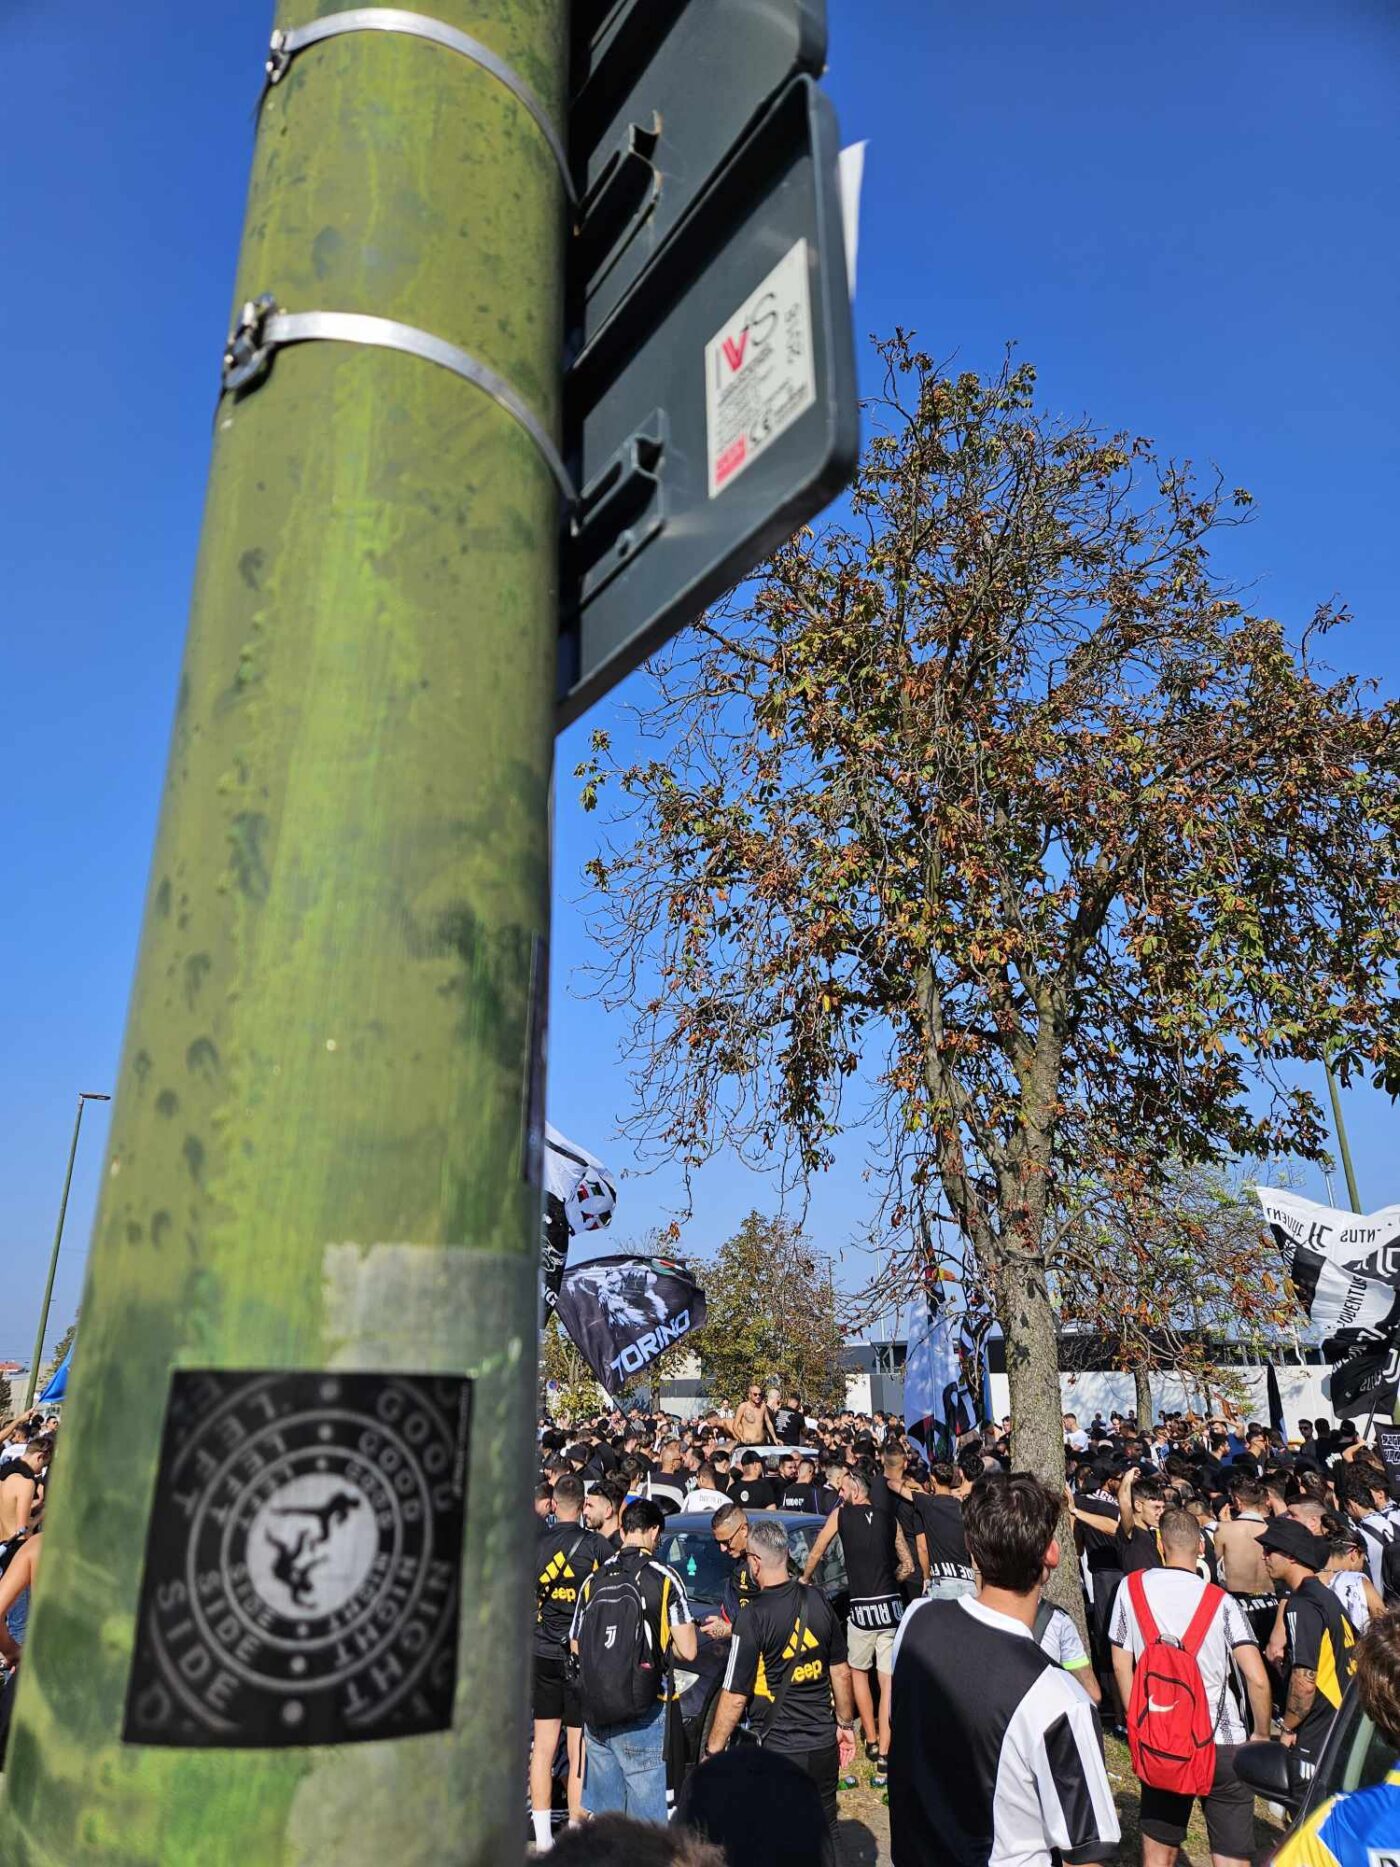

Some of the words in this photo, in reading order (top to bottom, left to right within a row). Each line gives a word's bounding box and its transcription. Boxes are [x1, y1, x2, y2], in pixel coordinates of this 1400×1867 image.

[609, 1309, 691, 1383] TORINO
[358, 1429, 421, 1523] GOOD
[197, 1569, 261, 1663] SIDE
[550, 1586, 577, 1603] eep
[156, 1577, 241, 1712] SIDE
[790, 1659, 823, 1683] eep
